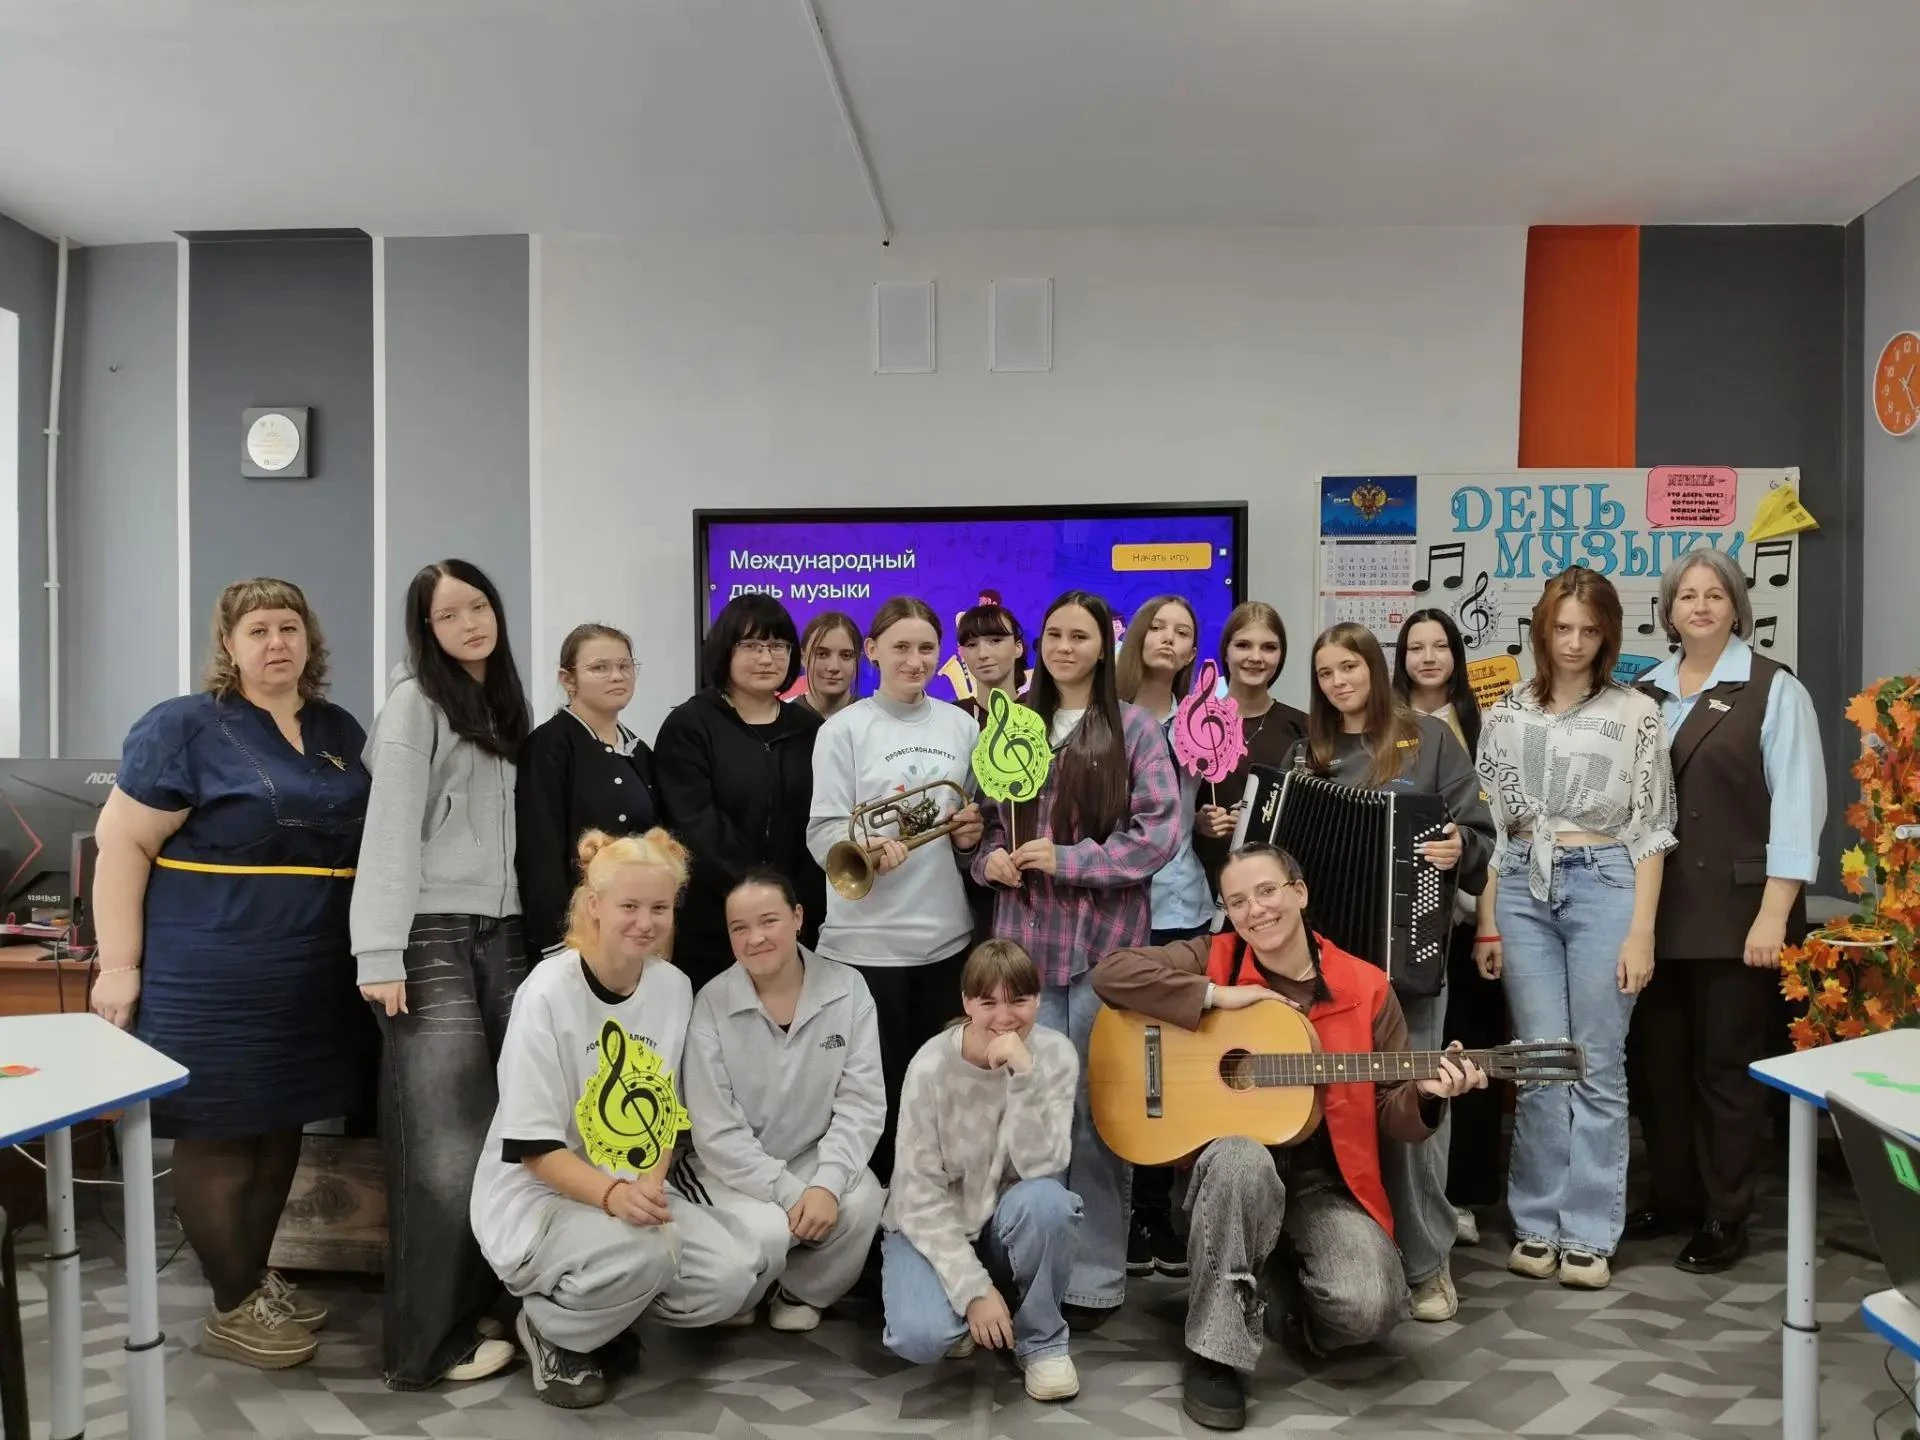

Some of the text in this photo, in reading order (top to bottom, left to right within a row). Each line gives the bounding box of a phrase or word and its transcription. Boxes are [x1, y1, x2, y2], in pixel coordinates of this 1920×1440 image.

[1451, 483, 1626, 533] ДЕНЬ
[730, 550, 916, 574] Международный
[1132, 553, 1191, 564] Начать игру
[790, 583, 870, 603] музыки
[84, 771, 117, 785] AOC
[628, 1032, 658, 1050] АЛИТЕТ
